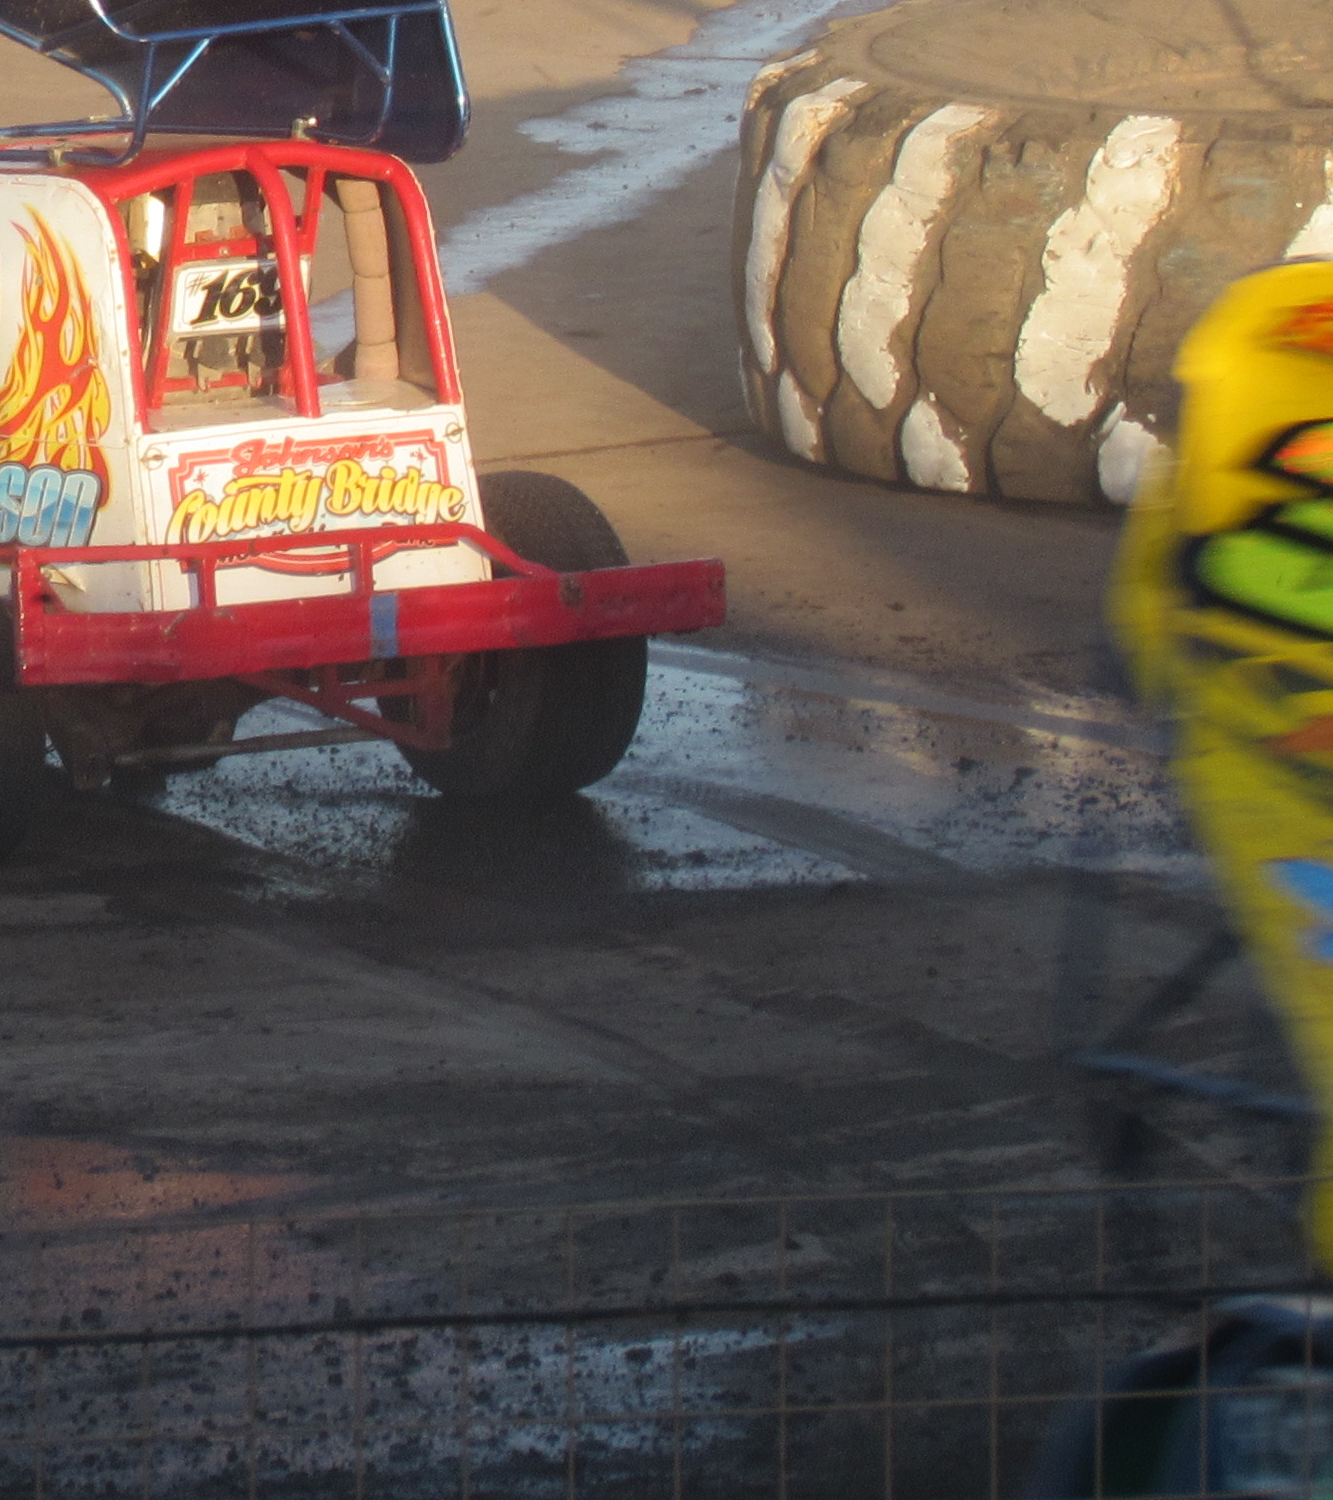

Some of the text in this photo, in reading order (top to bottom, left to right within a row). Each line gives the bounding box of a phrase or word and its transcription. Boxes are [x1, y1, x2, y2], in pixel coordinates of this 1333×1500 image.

[230, 436, 395, 477] Johnson's
[166, 459, 465, 545] County Bridge
